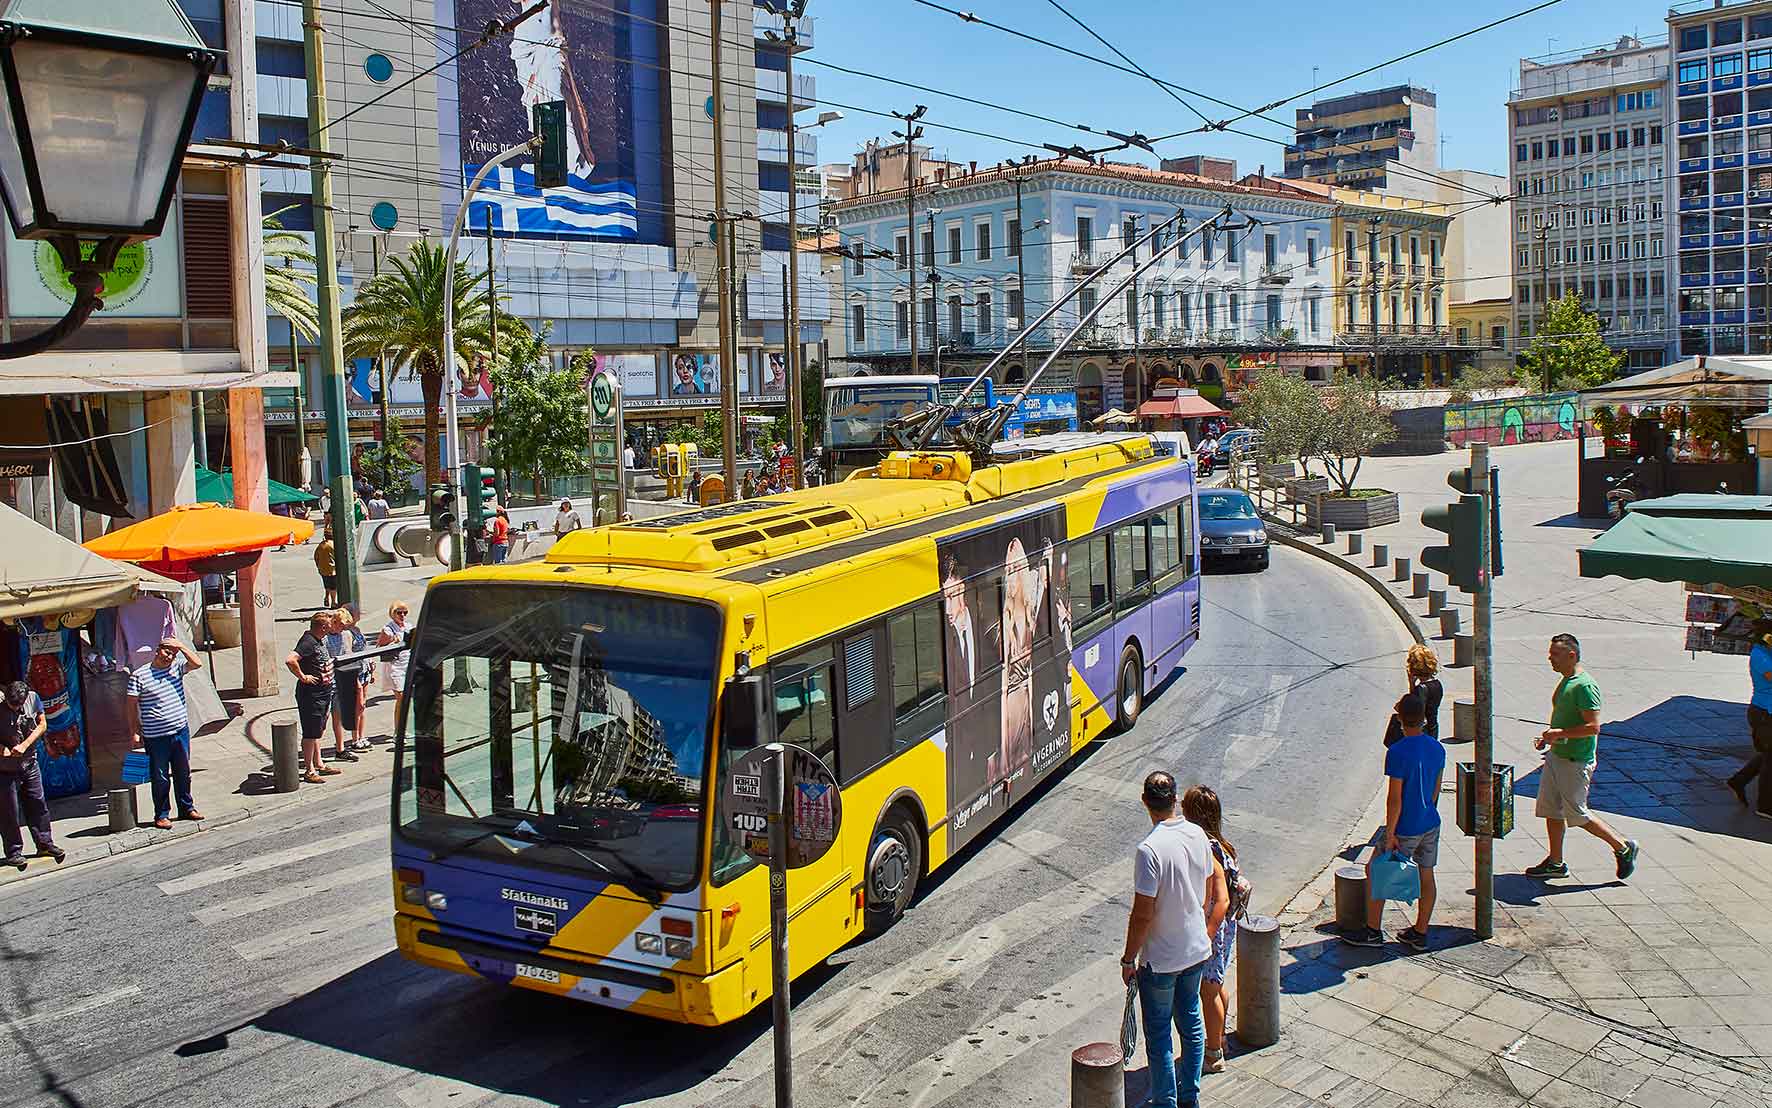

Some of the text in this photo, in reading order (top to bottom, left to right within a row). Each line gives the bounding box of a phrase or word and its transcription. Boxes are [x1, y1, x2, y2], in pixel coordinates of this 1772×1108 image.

[469, 139, 498, 153] VENUS
[734, 814, 767, 831] 1UP
[501, 888, 568, 910] Sfakianakis
